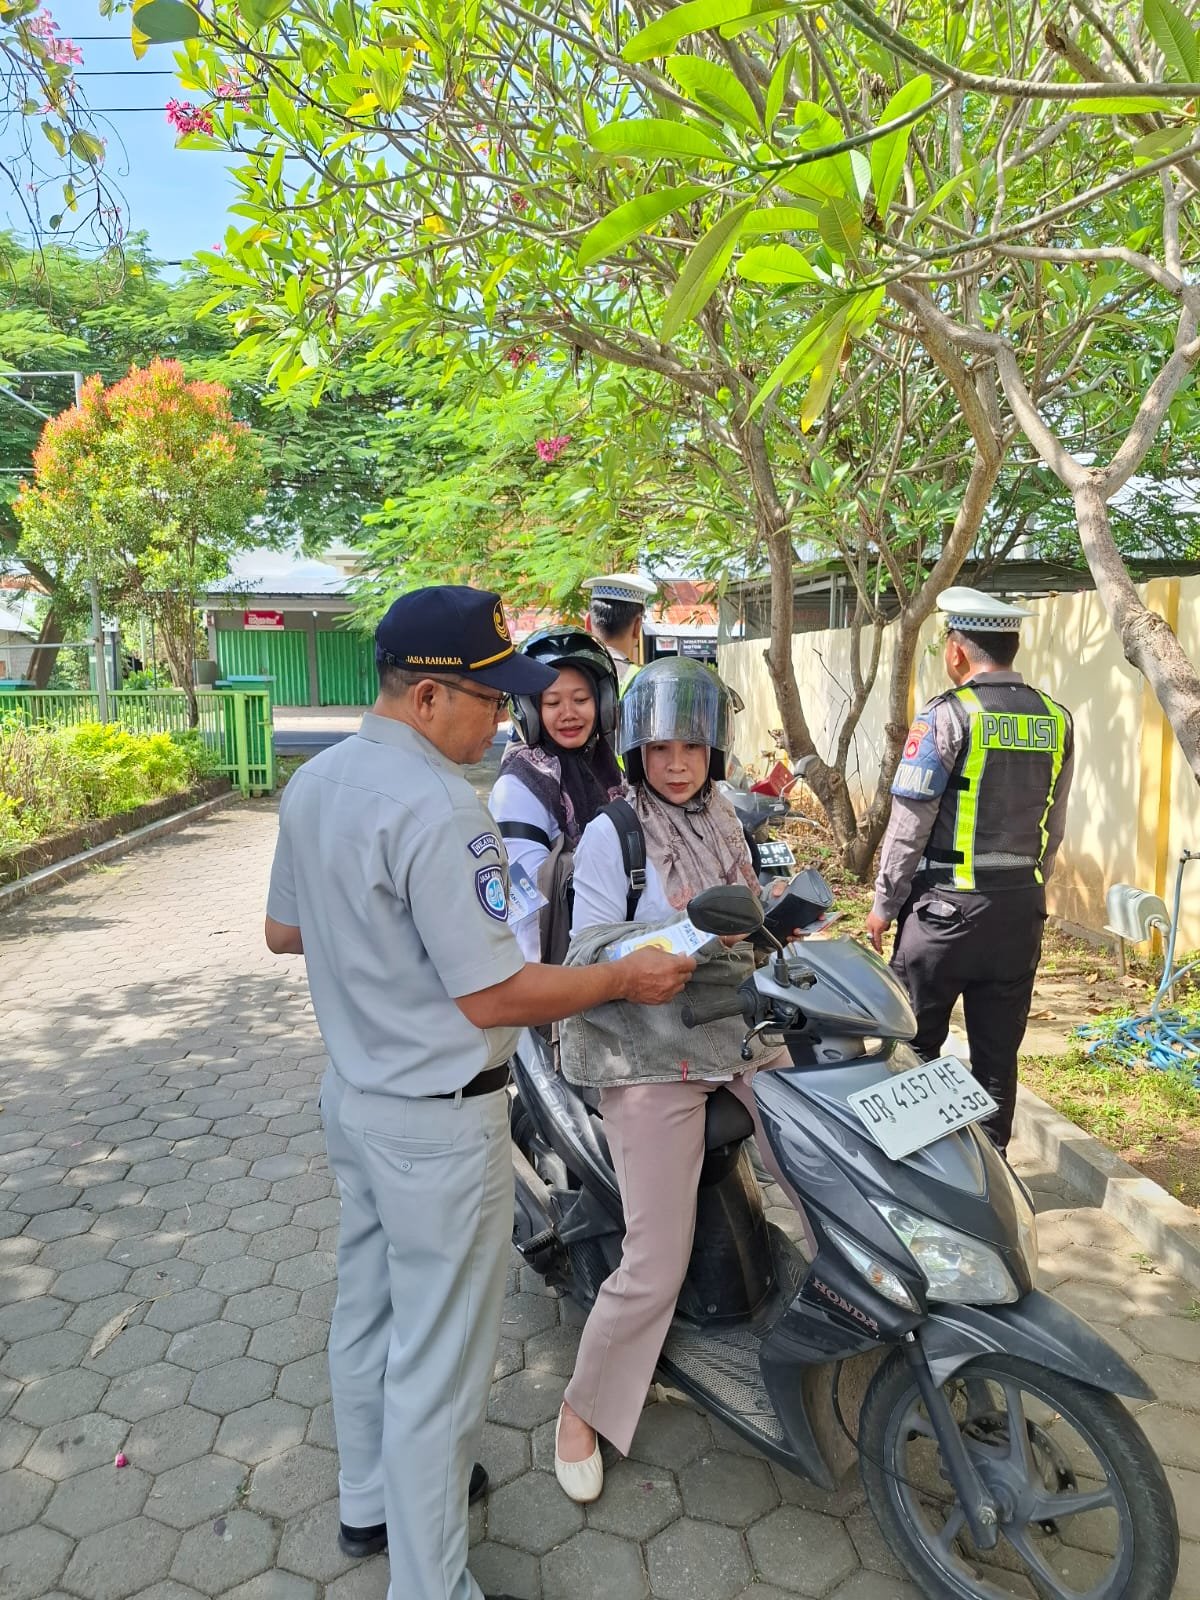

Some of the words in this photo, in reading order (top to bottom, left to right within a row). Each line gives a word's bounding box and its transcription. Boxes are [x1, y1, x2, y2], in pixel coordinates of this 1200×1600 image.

[405, 655, 424, 665] JASA
[425, 656, 463, 665] RAHARJA
[982, 714, 1057, 749] POLISI
[859, 1093, 894, 1123] DR
[891, 1073, 937, 1109] 4157
[933, 1063, 965, 1090] HE
[812, 1277, 880, 1332] HONDA
